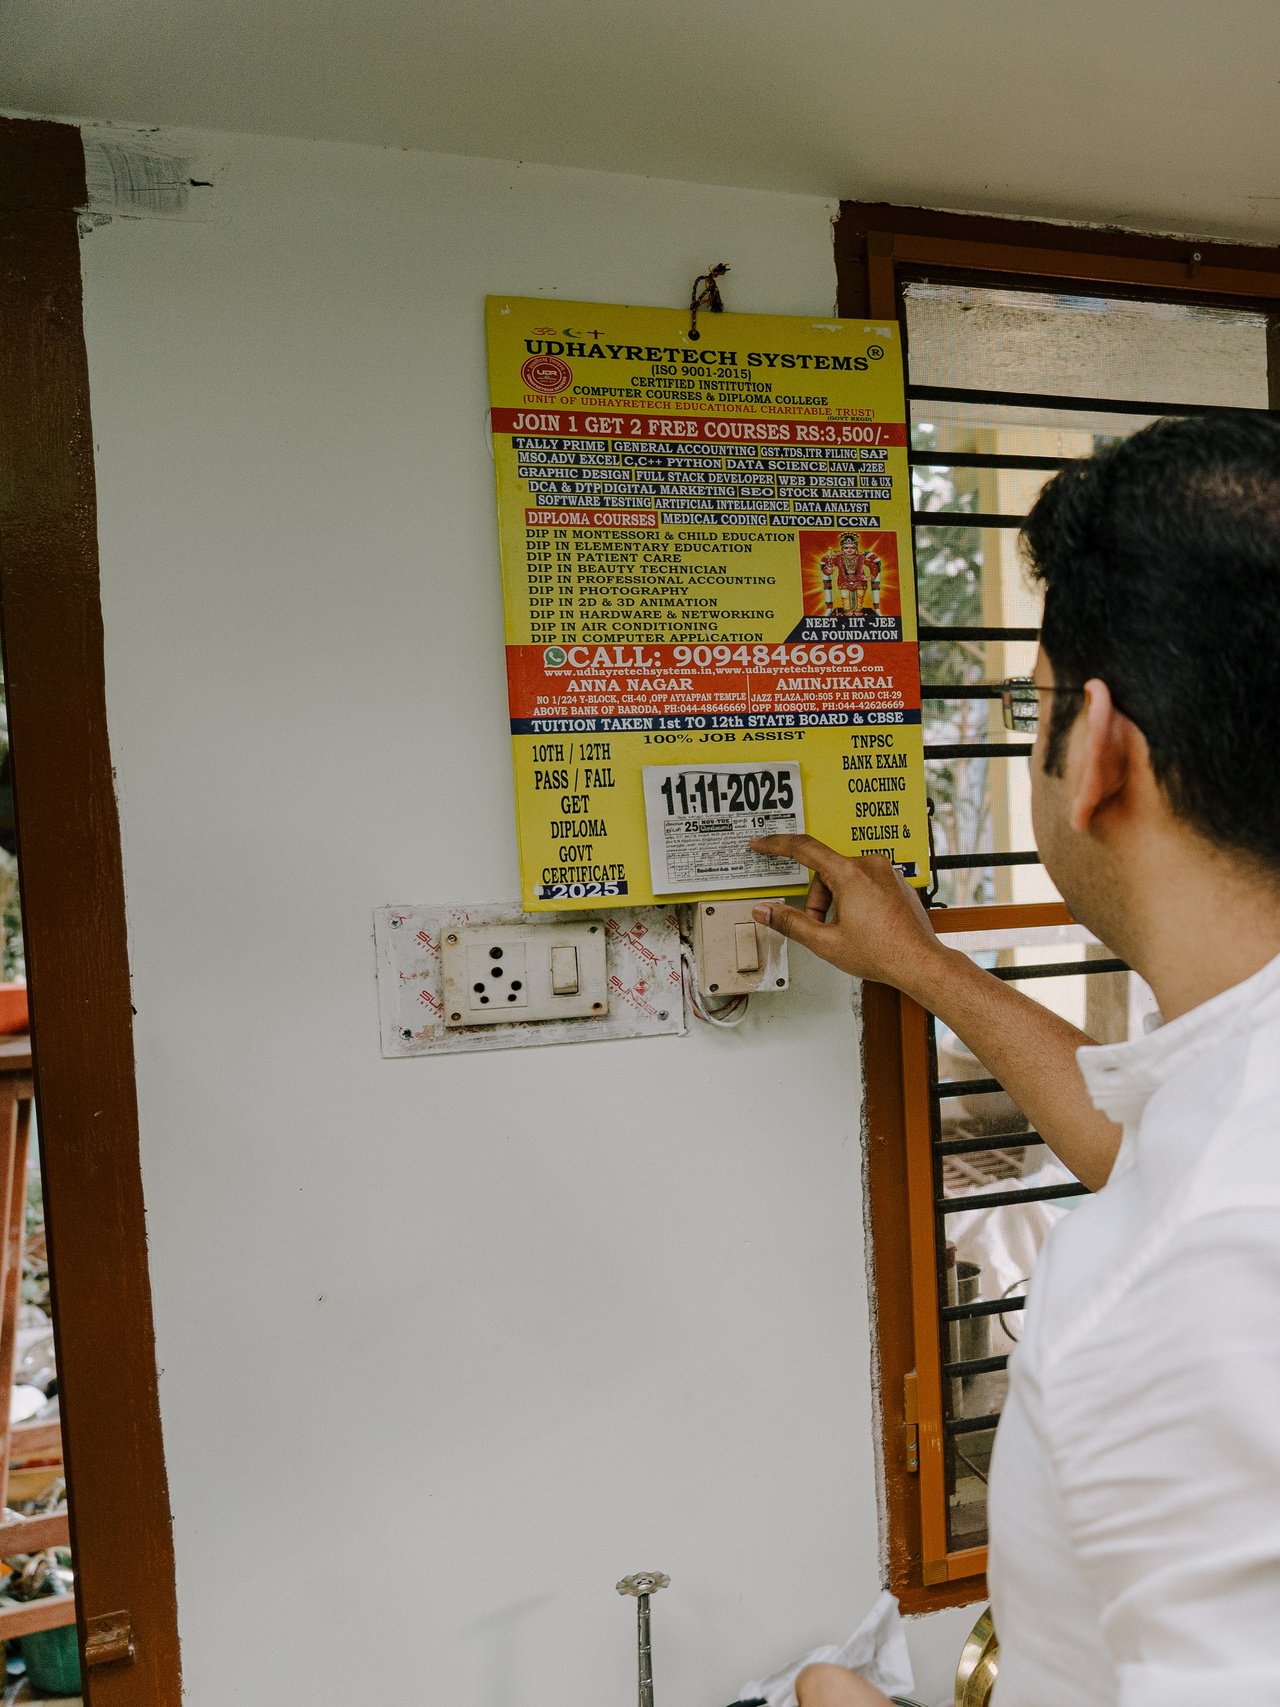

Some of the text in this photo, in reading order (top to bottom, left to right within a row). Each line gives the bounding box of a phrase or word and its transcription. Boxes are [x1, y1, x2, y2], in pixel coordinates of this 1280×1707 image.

[524, 339, 738, 365] UDHAYRETECH
[652, 365, 751, 381] (ISO 9001-2015)
[631, 377, 772, 392] CERTIFIED INSTITUTION
[573, 386, 828, 405] COMPUTER COURSES & DIPLOMA COLLEGE
[523, 394, 875, 418] (UNIT OF UDHAYRETECH EDUCATIONAL CHARITABLE TRUST)
[513, 414, 889, 445] JOIN 1 GET 2 FREE COURSES RS:3,500/-
[516, 438, 561, 450] TALLY
[563, 440, 605, 451] PRIME
[614, 441, 673, 453] GENERAL
[676, 443, 756, 456] ACCOUNTING
[825, 449, 857, 459] FILING
[860, 450, 887, 459] SAP
[580, 454, 619, 466] EXCEL
[624, 456, 662, 467] C,C++
[667, 457, 722, 469] PYTHON
[726, 460, 766, 470] DATA
[768, 462, 827, 471] SCIENCE
[830, 462, 855, 472] JAVA
[519, 467, 855, 487] GRAPHIC DESIGN FULL STACK DEVELOPER WEB DESIGN
[529, 481, 890, 498] DCA & DTP DIGITAL MARKETING SEO STOCK MARKETING
[538, 495, 868, 512] SOFTWARE TESTING ARTIFICIAL INTELLIGENCE DATA ANALYST
[528, 512, 879, 527] DIPLOMA COURSES MEDICAL CODING AUTOCAD CCNA
[526, 553, 682, 562] DIP IN PATIENT CARE
[528, 575, 776, 584] DIP IN PROFESSIONAL ACCOUNTING
[528, 586, 689, 595] DIP IN PHOTOGRAPHY
[529, 598, 717, 606] DIP IN 2D & 3D ANIMATION
[531, 634, 763, 643] DIP IN COMPUTER APPLICATION
[802, 631, 897, 640] CA FOUNDATION
[568, 645, 864, 667] CALL: 9094846669
[567, 679, 694, 692] ANNA NAGAR
[776, 677, 893, 690] AMINJIKARAI
[537, 696, 549, 704] NO
[552, 696, 577, 704] 1/224
[580, 695, 619, 704] Y-BLOCK,
[622, 694, 646, 702] CH-40
[670, 693, 712, 702] AYYAPPAN
[714, 693, 746, 701] TEMPLE
[751, 693, 772, 702] JAZZ
[852, 691, 875, 700] ROAD
[877, 691, 901, 699] CH-29
[533, 703, 746, 716] ABOVE BANK OF BARODA, PH:044-48646669
[752, 701, 904, 712] OPP MOSQUE, PH:044-42626669
[531, 711, 903, 732] TUITION TAKEN 1st TO 12th STATE BOARD & CBSE
[644, 731, 805, 744] 100% JOB ASSIST
[851, 734, 893, 748] TNPSC
[533, 743, 611, 764] 10TH / 12TH
[842, 754, 907, 770] BANK EXAM
[534, 768, 615, 792] PASS / FAIL
[848, 777, 905, 793] COACHING
[661, 771, 793, 815] 11-11-2025
[561, 795, 590, 814] GET
[855, 801, 899, 817] SPOKEN
[551, 819, 607, 838] DIPLOMA
[685, 821, 698, 832] 25
[751, 817, 764, 828] 19
[851, 824, 910, 841] ENGLISH &
[559, 845, 593, 862] GOVT
[542, 864, 625, 884] CERTIFICATE
[552, 882, 619, 899] 2025
